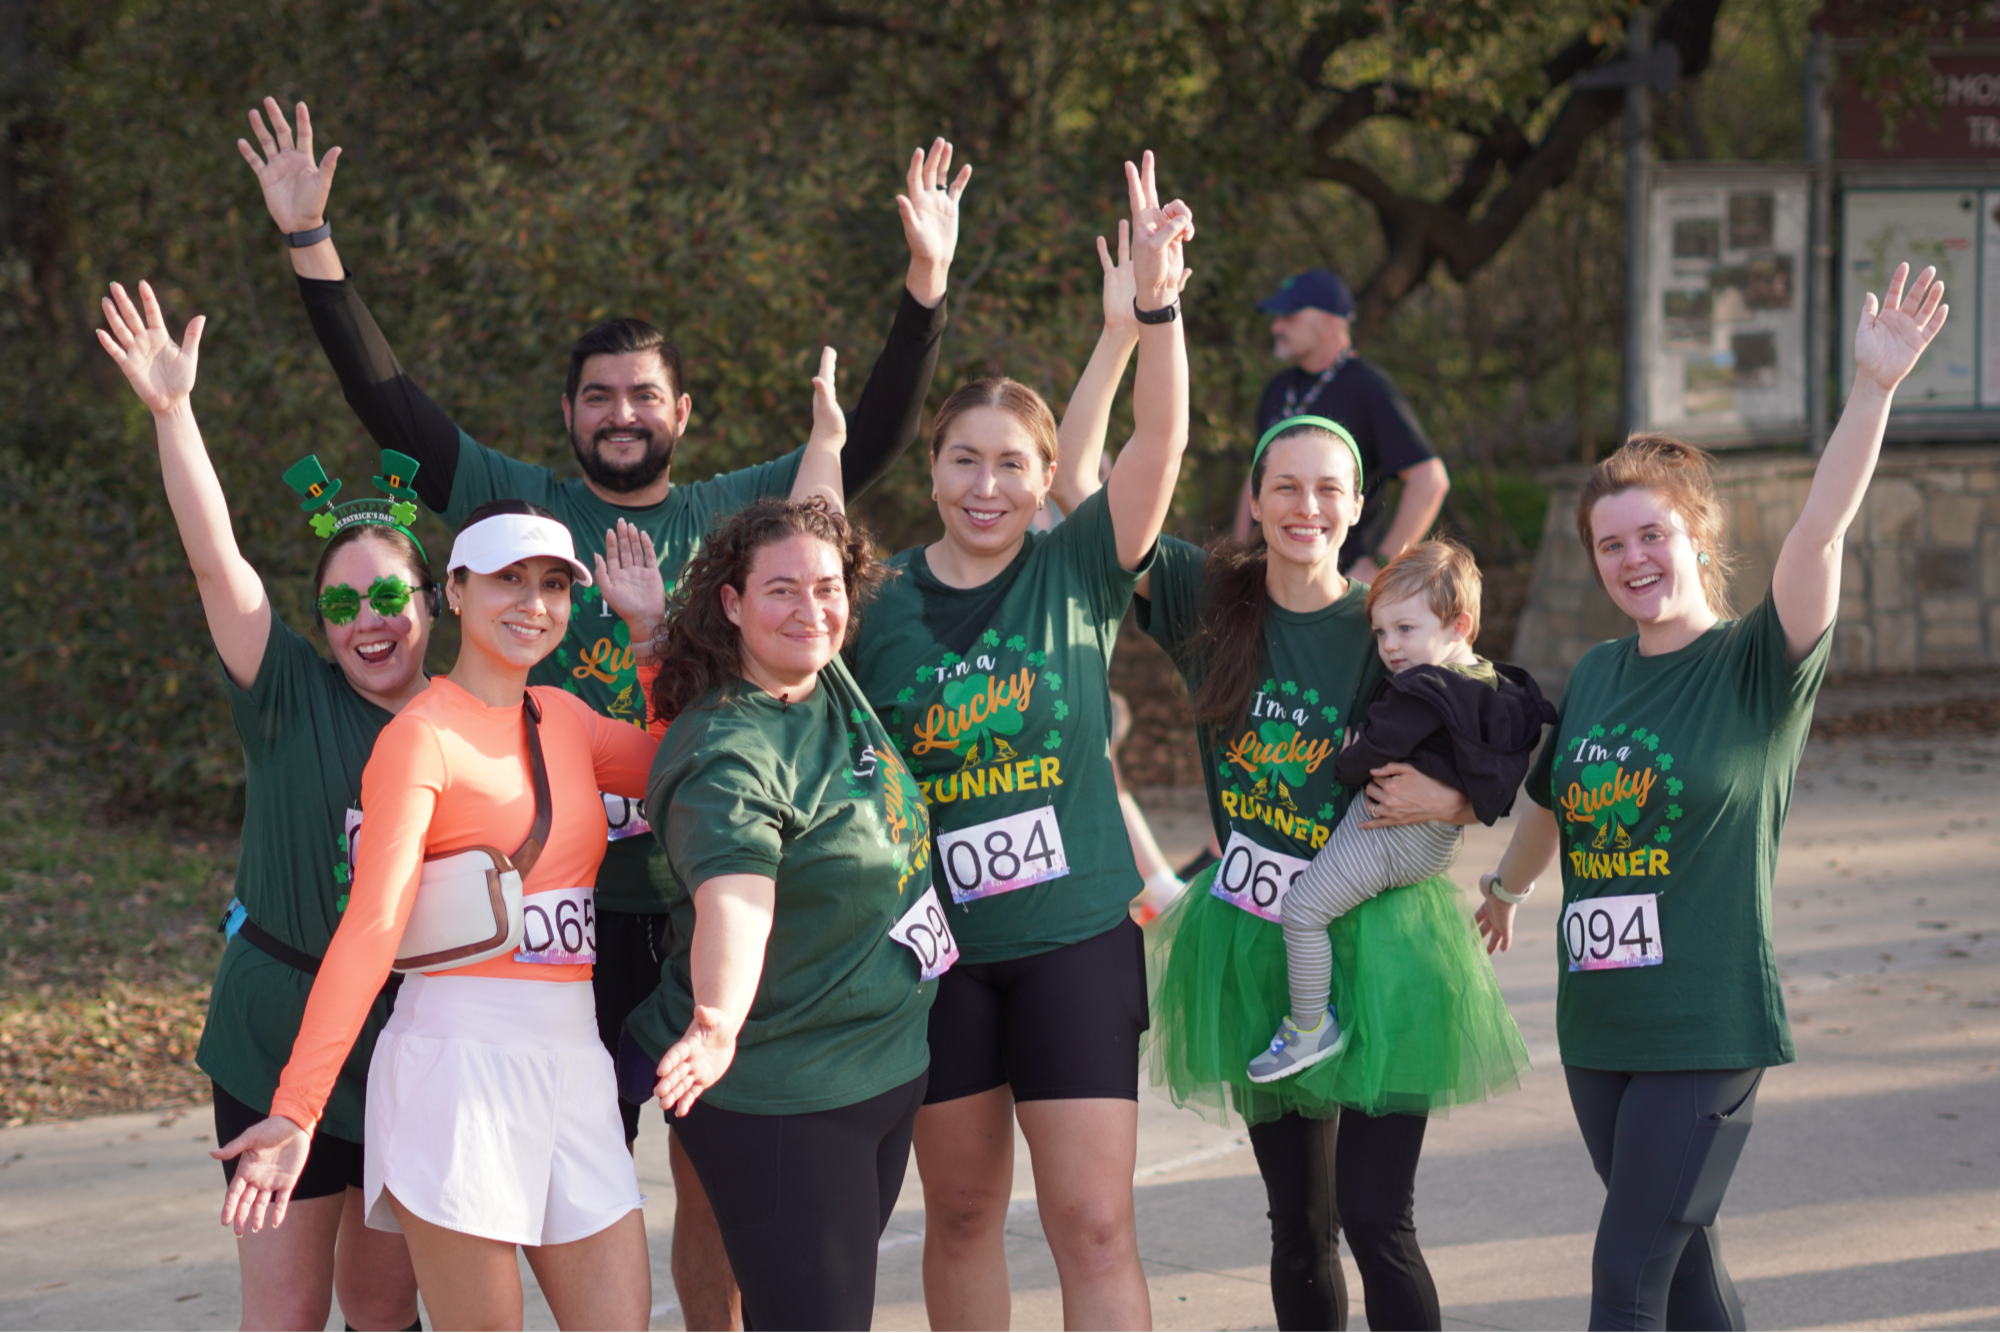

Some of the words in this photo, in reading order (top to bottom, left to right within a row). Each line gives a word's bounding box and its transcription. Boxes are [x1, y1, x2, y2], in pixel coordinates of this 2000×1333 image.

[338, 503, 386, 518] HAPPY
[976, 653, 997, 671] a
[912, 667, 1036, 756] Lucky
[1251, 691, 1287, 720] I'm
[1291, 706, 1310, 727] a
[1225, 729, 1334, 775] Lucky
[1573, 738, 1611, 764] I'm
[1616, 744, 1632, 761] a
[917, 756, 1064, 806] RUNNER
[1560, 766, 1658, 823] Lucky
[1221, 789, 1330, 850] RUNNER
[946, 818, 1057, 891] 084
[1221, 845, 1305, 907] 06
[1568, 848, 1671, 879] RUNNER
[904, 898, 952, 970] 09
[1566, 906, 1653, 962] 094
